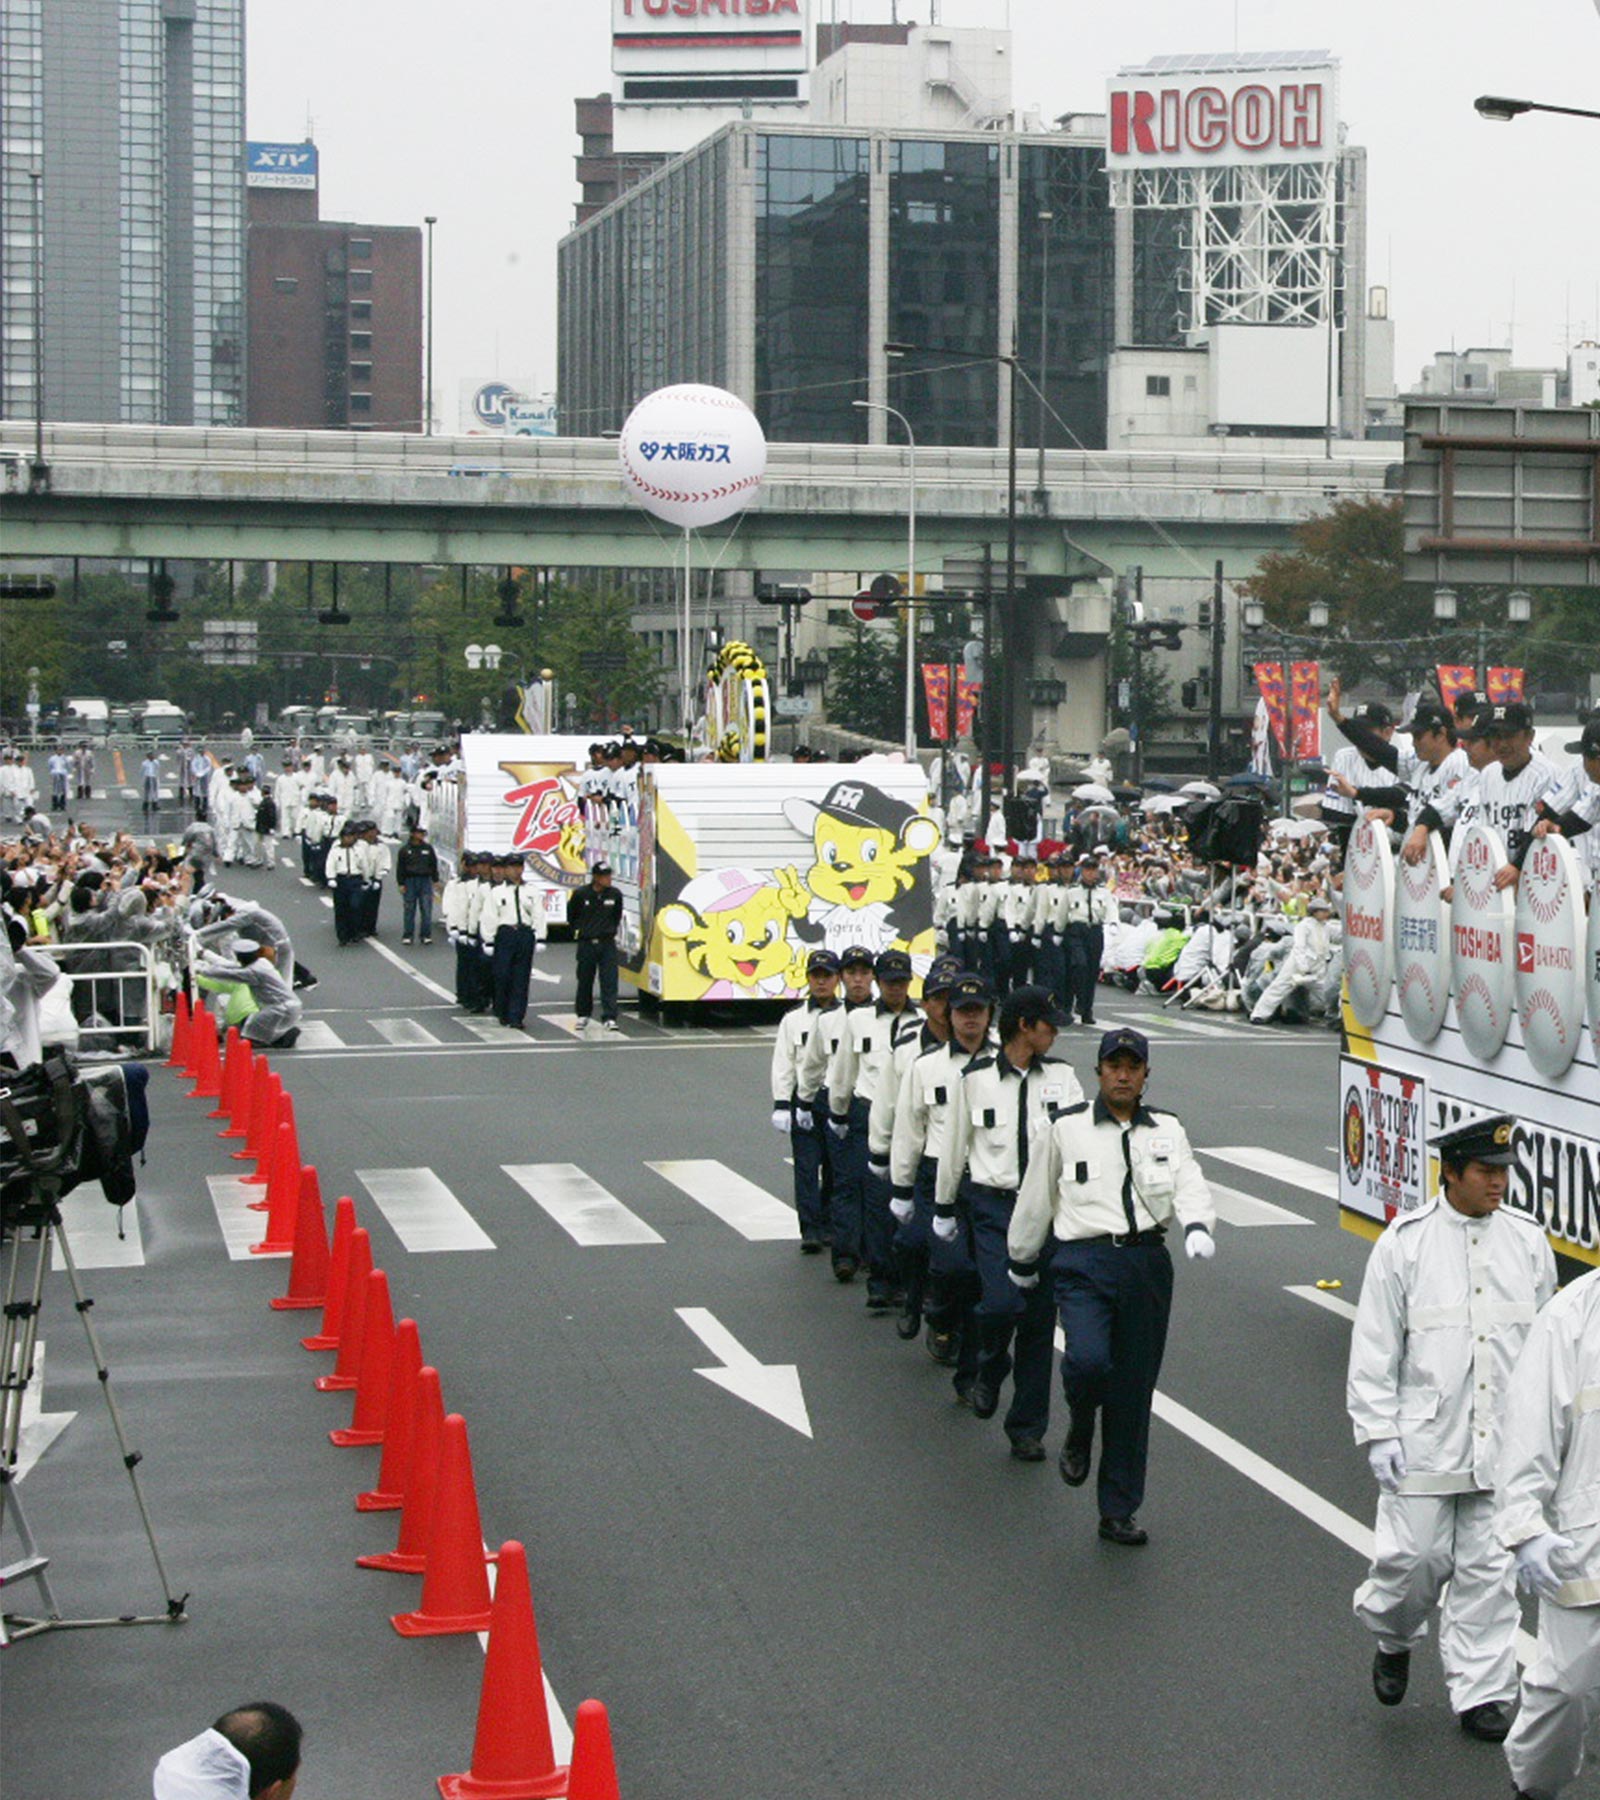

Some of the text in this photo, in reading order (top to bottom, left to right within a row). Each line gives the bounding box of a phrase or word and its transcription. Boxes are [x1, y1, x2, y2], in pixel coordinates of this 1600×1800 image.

[1111, 84, 1322, 153] RICOH
[661, 443, 731, 463] 大阪ガス
[828, 921, 863, 937] igers
[1345, 902, 1385, 943] National
[1454, 923, 1502, 964] TOSHIBA
[1535, 944, 1573, 971] DAIHATSU
[1366, 1087, 1419, 1141] VICTORY
[1366, 1132, 1420, 1188] PARADE
